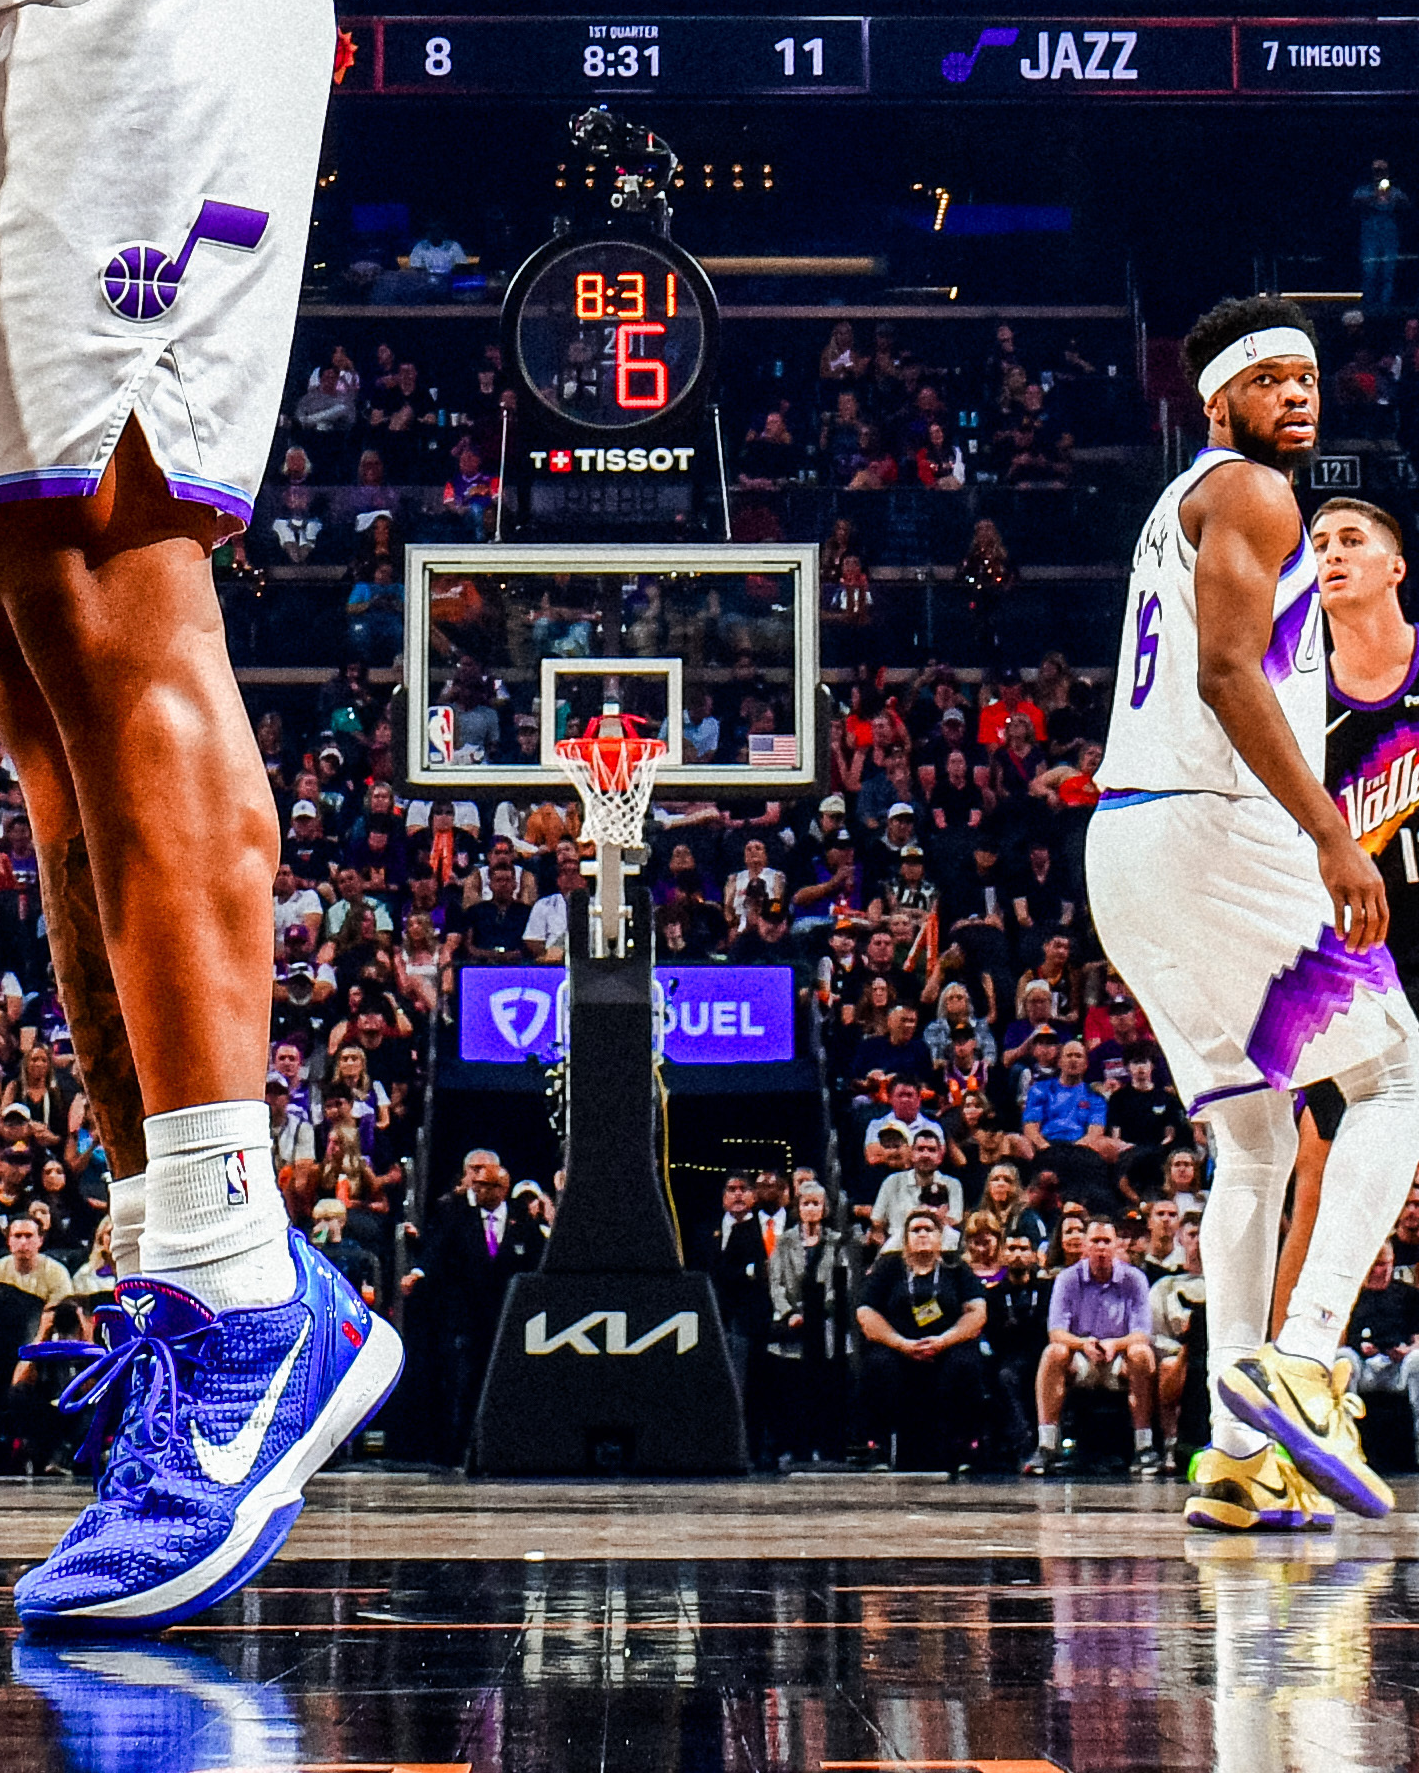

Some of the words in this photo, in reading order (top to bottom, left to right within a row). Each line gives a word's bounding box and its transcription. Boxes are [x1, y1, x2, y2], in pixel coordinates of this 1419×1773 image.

[589, 25, 608, 39] 1ST
[610, 25, 660, 39] QUARTER
[424, 37, 453, 77] 8
[583, 45, 661, 77] 8:31
[774, 38, 825, 77] 11
[1020, 31, 1138, 80] JAZZ
[1263, 41, 1279, 71] 7
[1287, 45, 1381, 67] TIMEOUTS
[575, 272, 678, 319] 8:31
[616, 322, 668, 410] 6
[574, 447, 695, 472] TISSOT
[1321, 461, 1351, 483] 121
[525, 1311, 698, 1355] KIA
